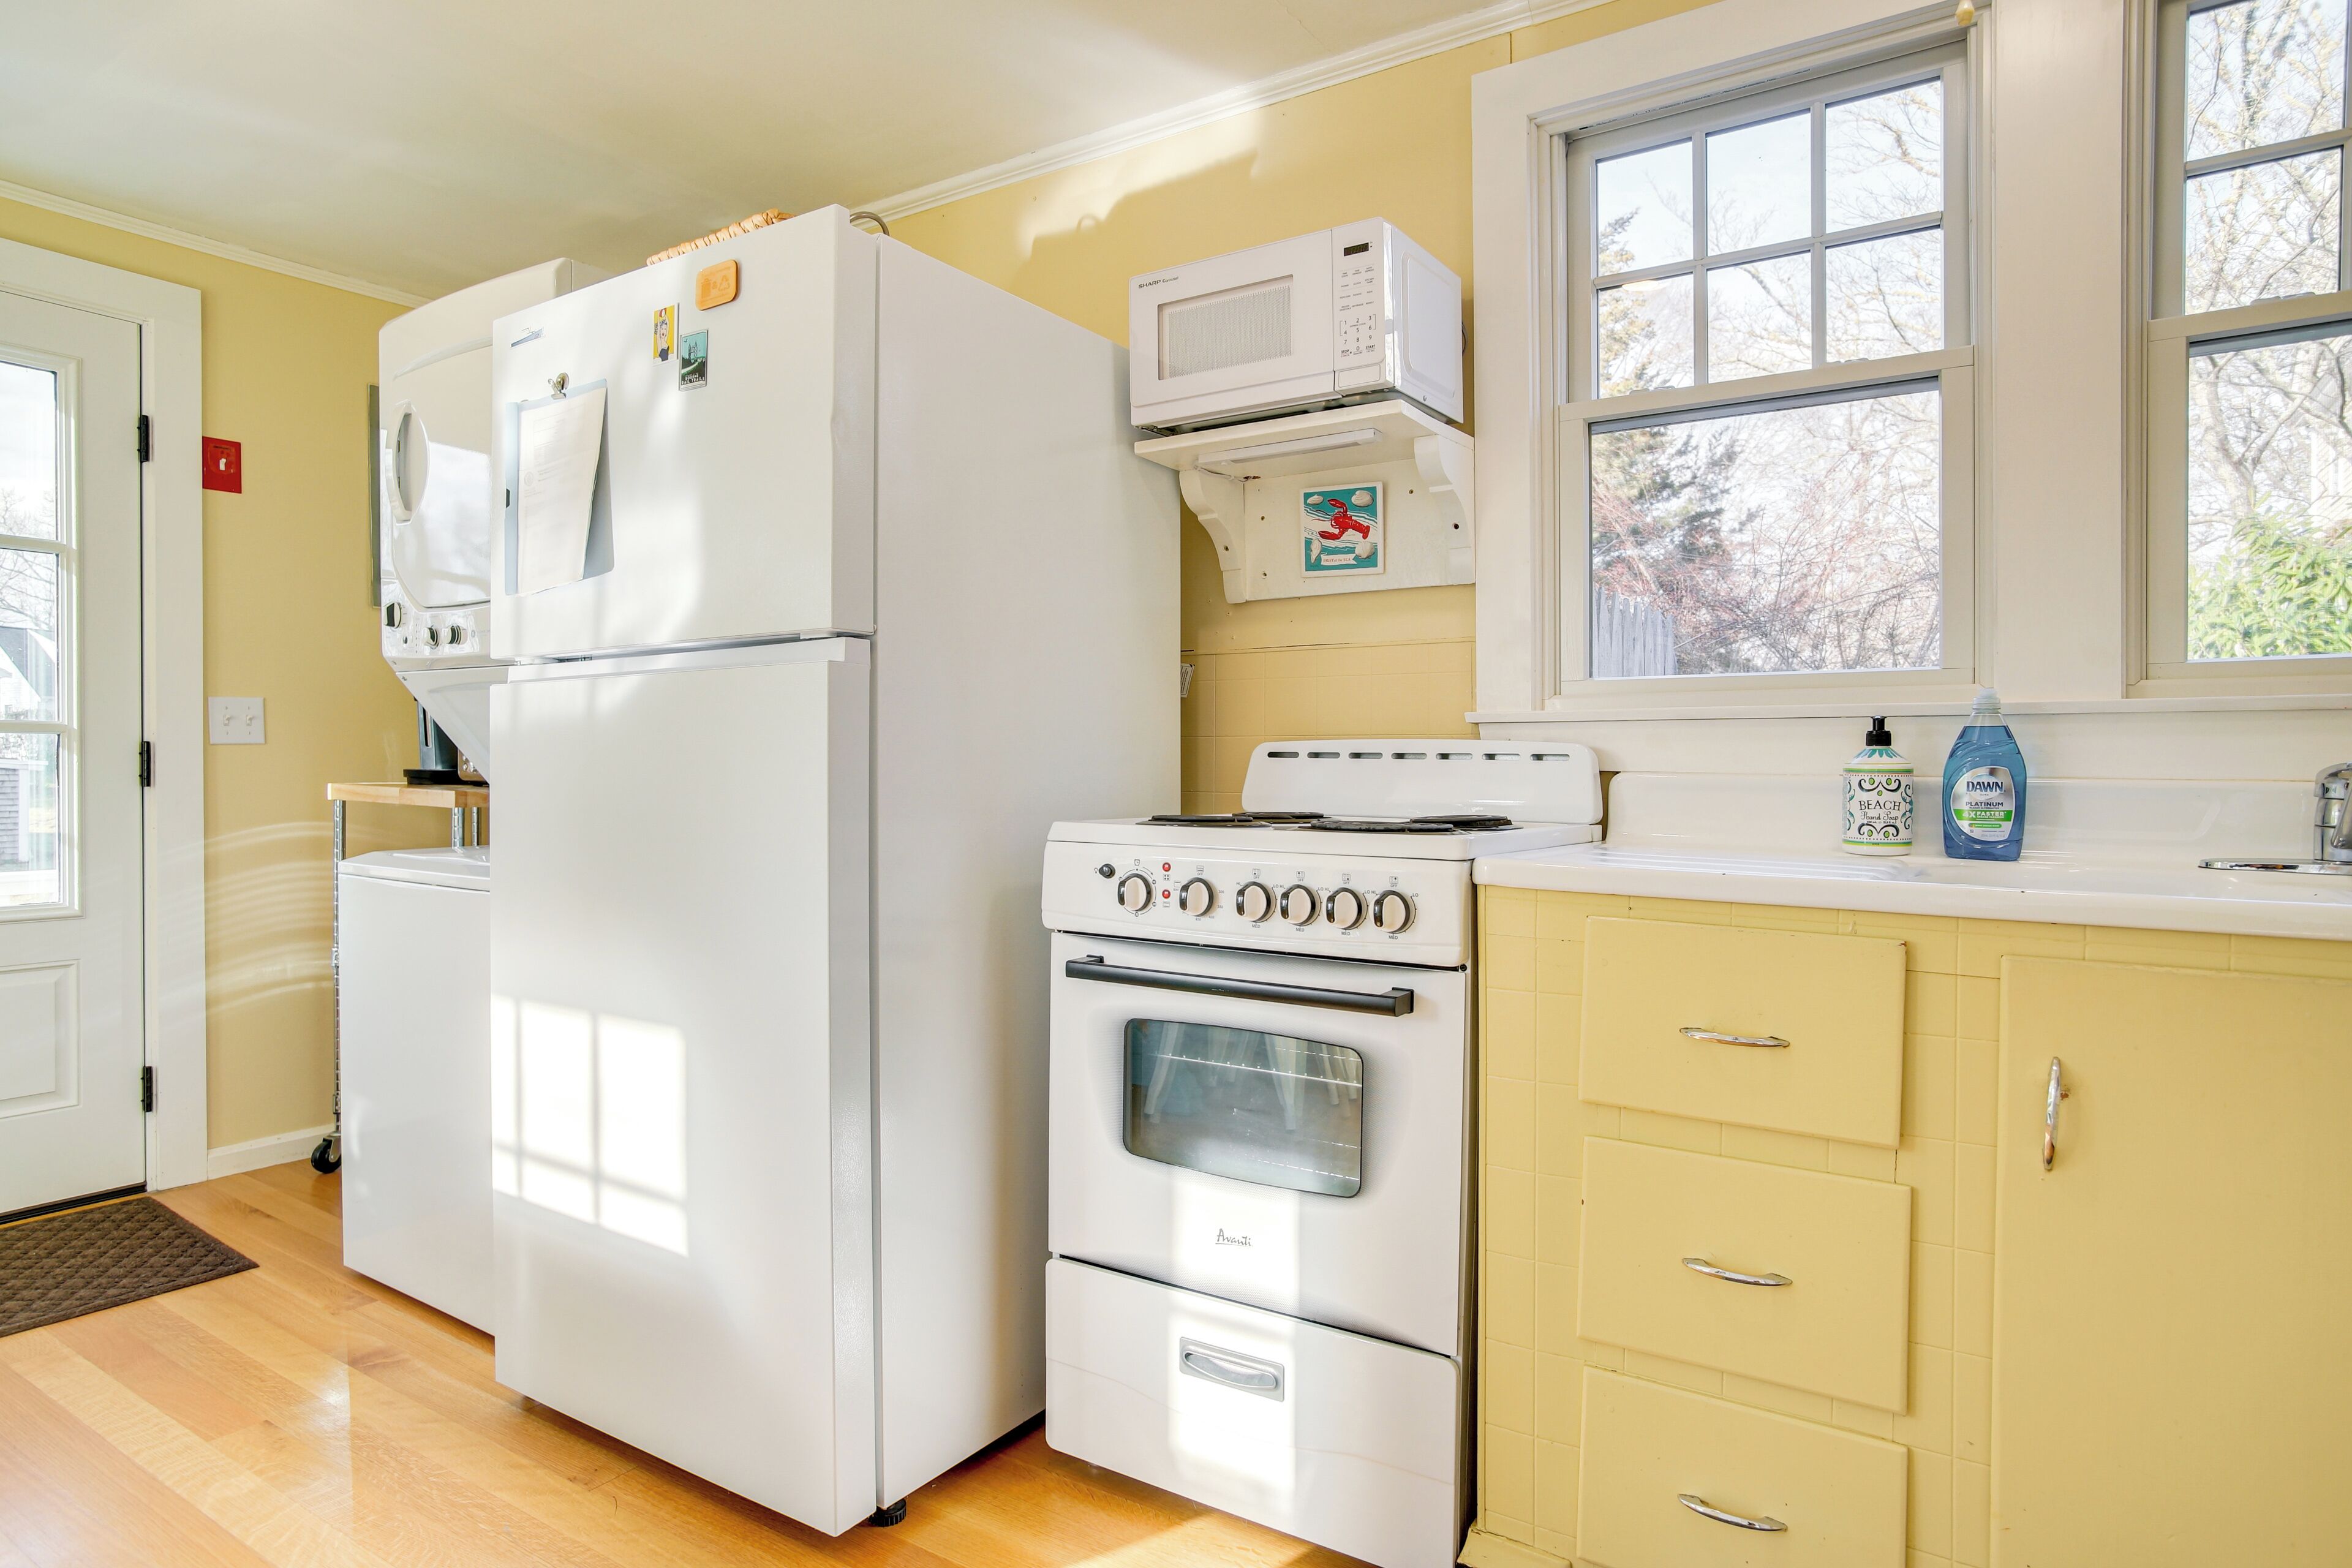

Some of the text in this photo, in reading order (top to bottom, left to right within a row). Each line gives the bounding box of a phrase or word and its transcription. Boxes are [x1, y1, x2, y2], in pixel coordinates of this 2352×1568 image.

[1138, 279, 1161, 288] SHARP
[1966, 782, 2003, 793] DAWN
[1858, 800, 1901, 811] BEACH
[1861, 811, 1899, 823] Hand Soap
[1216, 1228, 1251, 1246] Avanti
